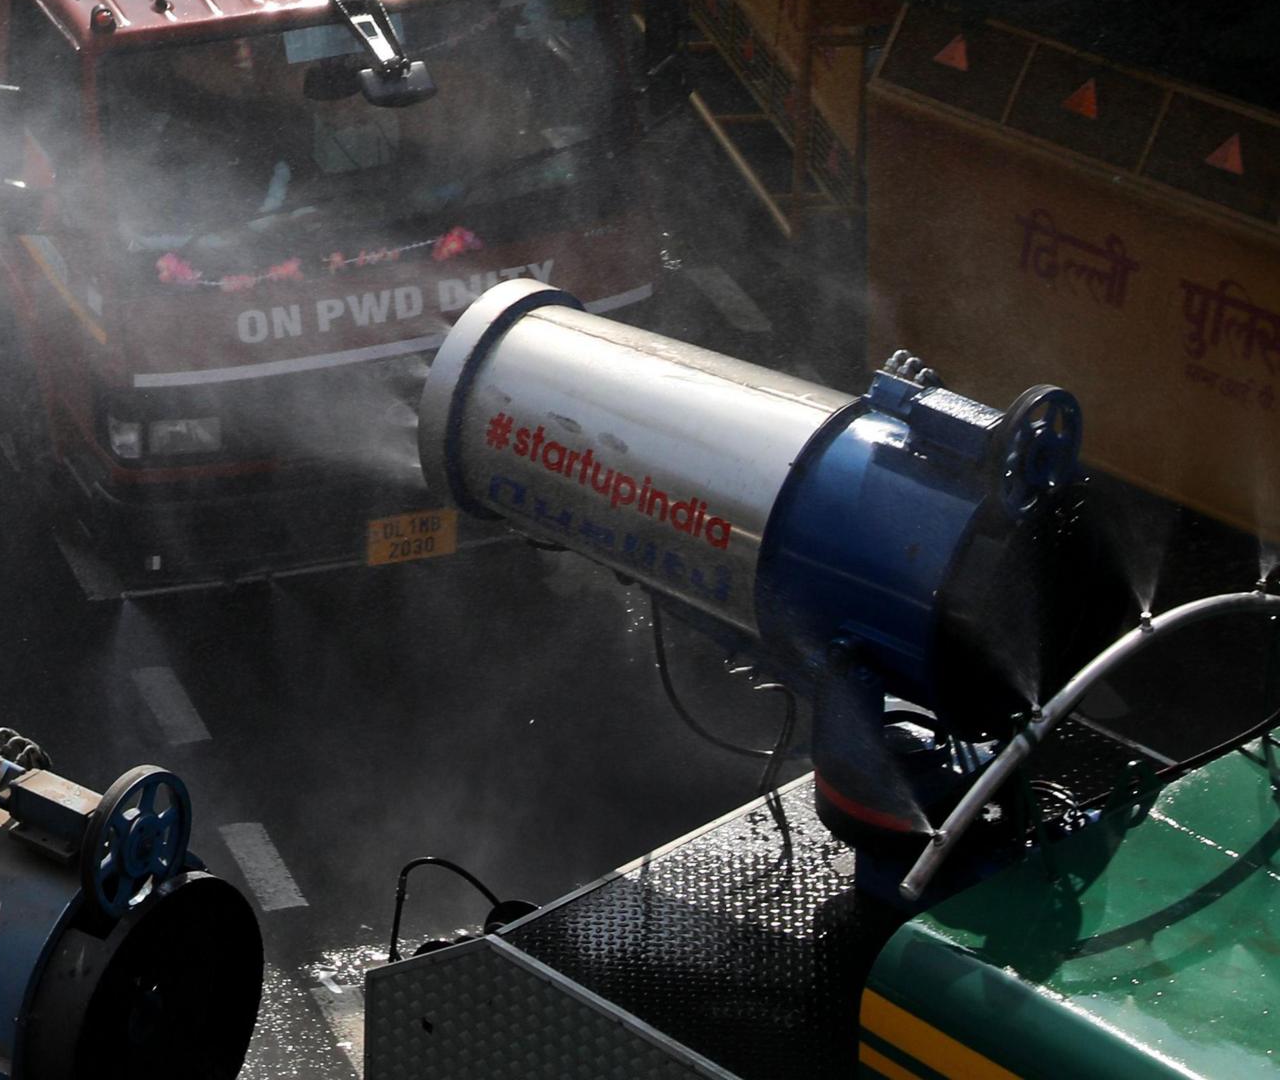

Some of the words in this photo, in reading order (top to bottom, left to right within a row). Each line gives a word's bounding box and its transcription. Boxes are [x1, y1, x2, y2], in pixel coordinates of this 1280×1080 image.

[236, 304, 303, 344] ON
[316, 285, 424, 332] PWD
[486, 411, 732, 551] #startupindia
